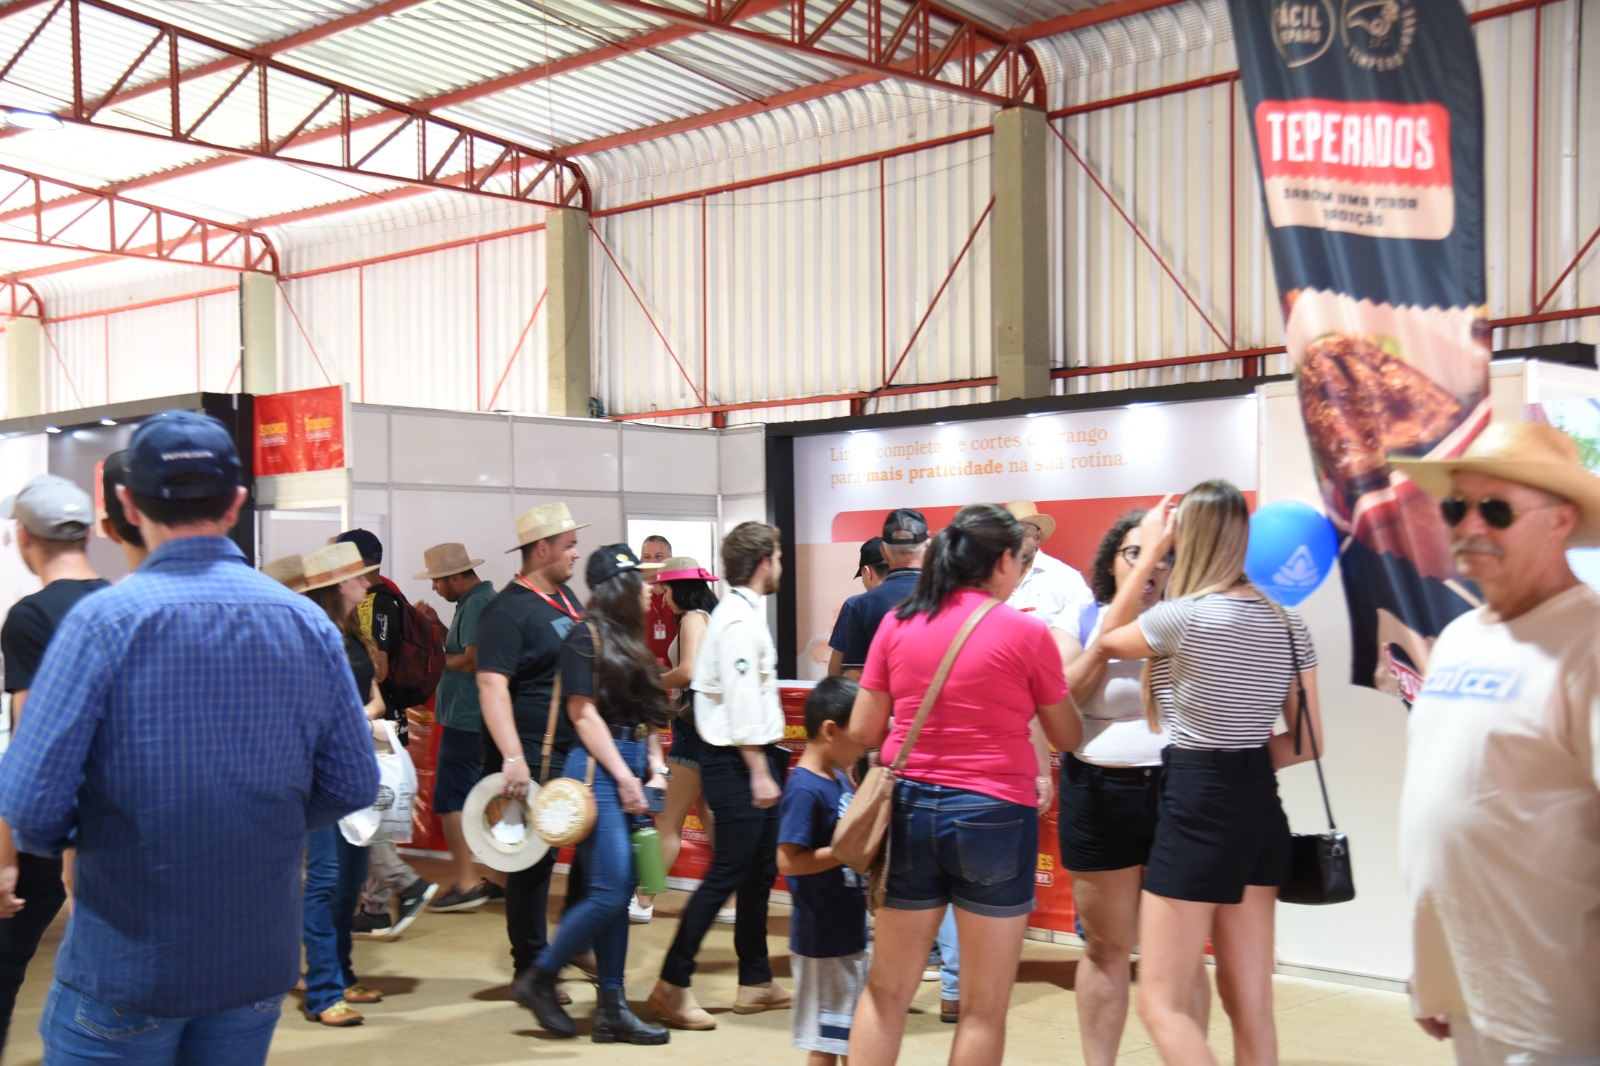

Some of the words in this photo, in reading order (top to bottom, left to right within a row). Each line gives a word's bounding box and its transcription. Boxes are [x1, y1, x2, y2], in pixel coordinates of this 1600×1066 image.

[971, 434, 1022, 451] cortes
[1059, 427, 1108, 447] rango
[831, 471, 861, 489] para
[866, 466, 903, 483] mais
[908, 457, 1003, 485] praticidade
[1009, 459, 1029, 473] na
[1035, 455, 1064, 471] sua
